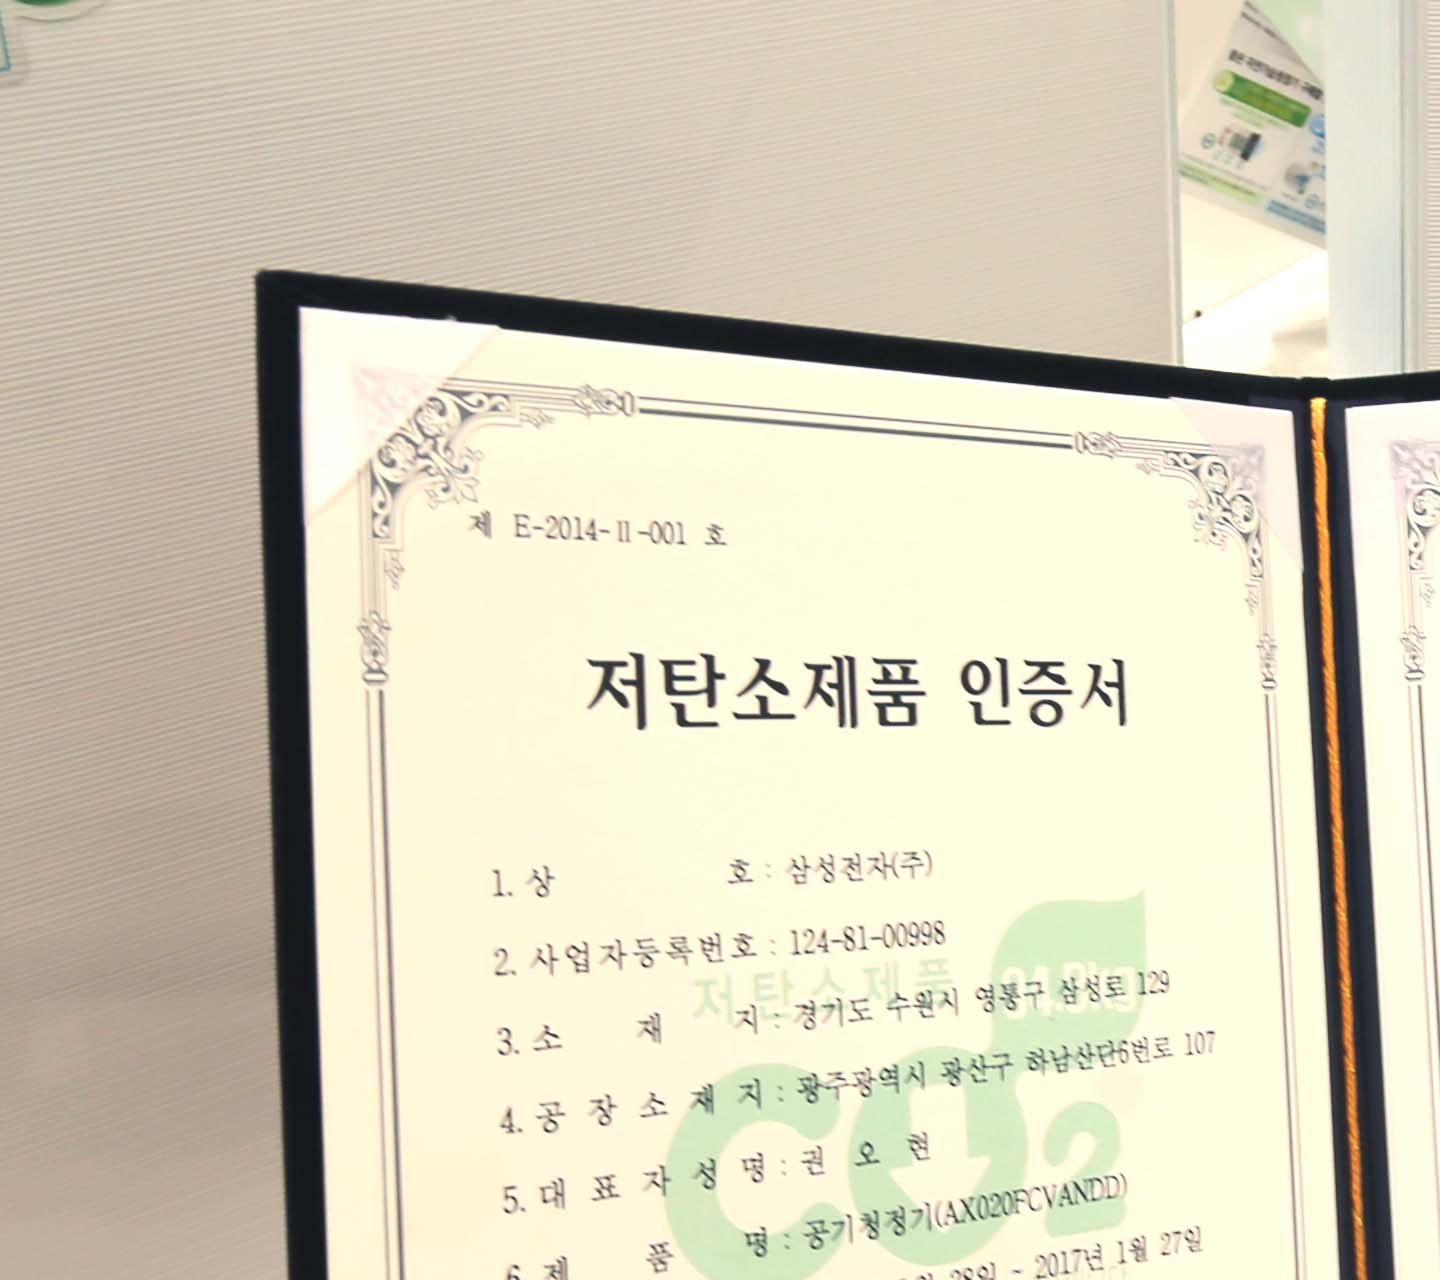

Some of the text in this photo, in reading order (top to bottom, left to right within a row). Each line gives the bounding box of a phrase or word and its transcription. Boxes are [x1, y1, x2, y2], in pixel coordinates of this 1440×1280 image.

[470, 510, 492, 538] 제
[704, 524, 727, 546] 호
[587, 652, 1126, 730] 저탄소제품 인증서
[787, 850, 932, 885] 삼성전자(주)
[531, 920, 946, 976] 사업자등록번호 124-81-00998
[795, 997, 873, 1031] 경기도
[886, 987, 958, 1021] 수원시
[975, 981, 1045, 1013] 영통구
[1057, 975, 1126, 1005] 삼성로
[1137, 970, 1170, 996] 129
[797, 1030, 1215, 1104] 광주광역시 광산구 하남산단6번로 107
[1035, 1243, 1104, 1280] 2017년
[1117, 1235, 1148, 1265] 1월
[1160, 1226, 1202, 1256] 27일
